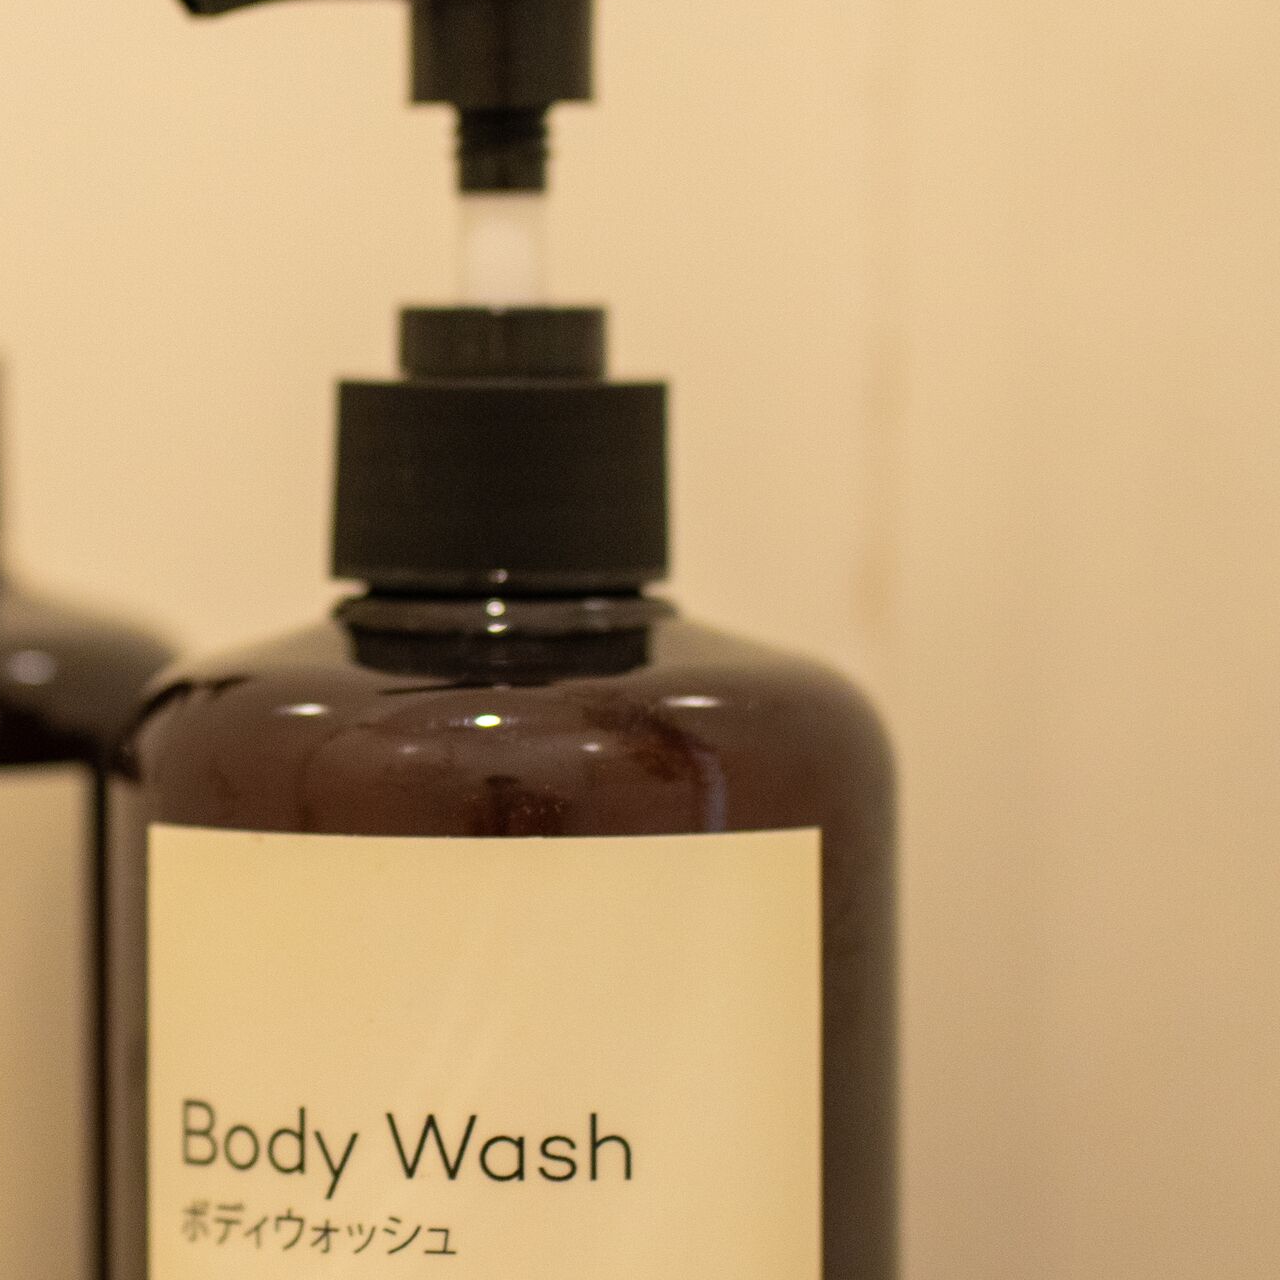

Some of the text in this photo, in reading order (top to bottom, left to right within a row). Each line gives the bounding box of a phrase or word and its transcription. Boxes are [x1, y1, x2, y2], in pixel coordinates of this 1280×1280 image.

[182, 1099, 632, 1200] Body Wash
[181, 1199, 457, 1255] ボディウォッシュ
